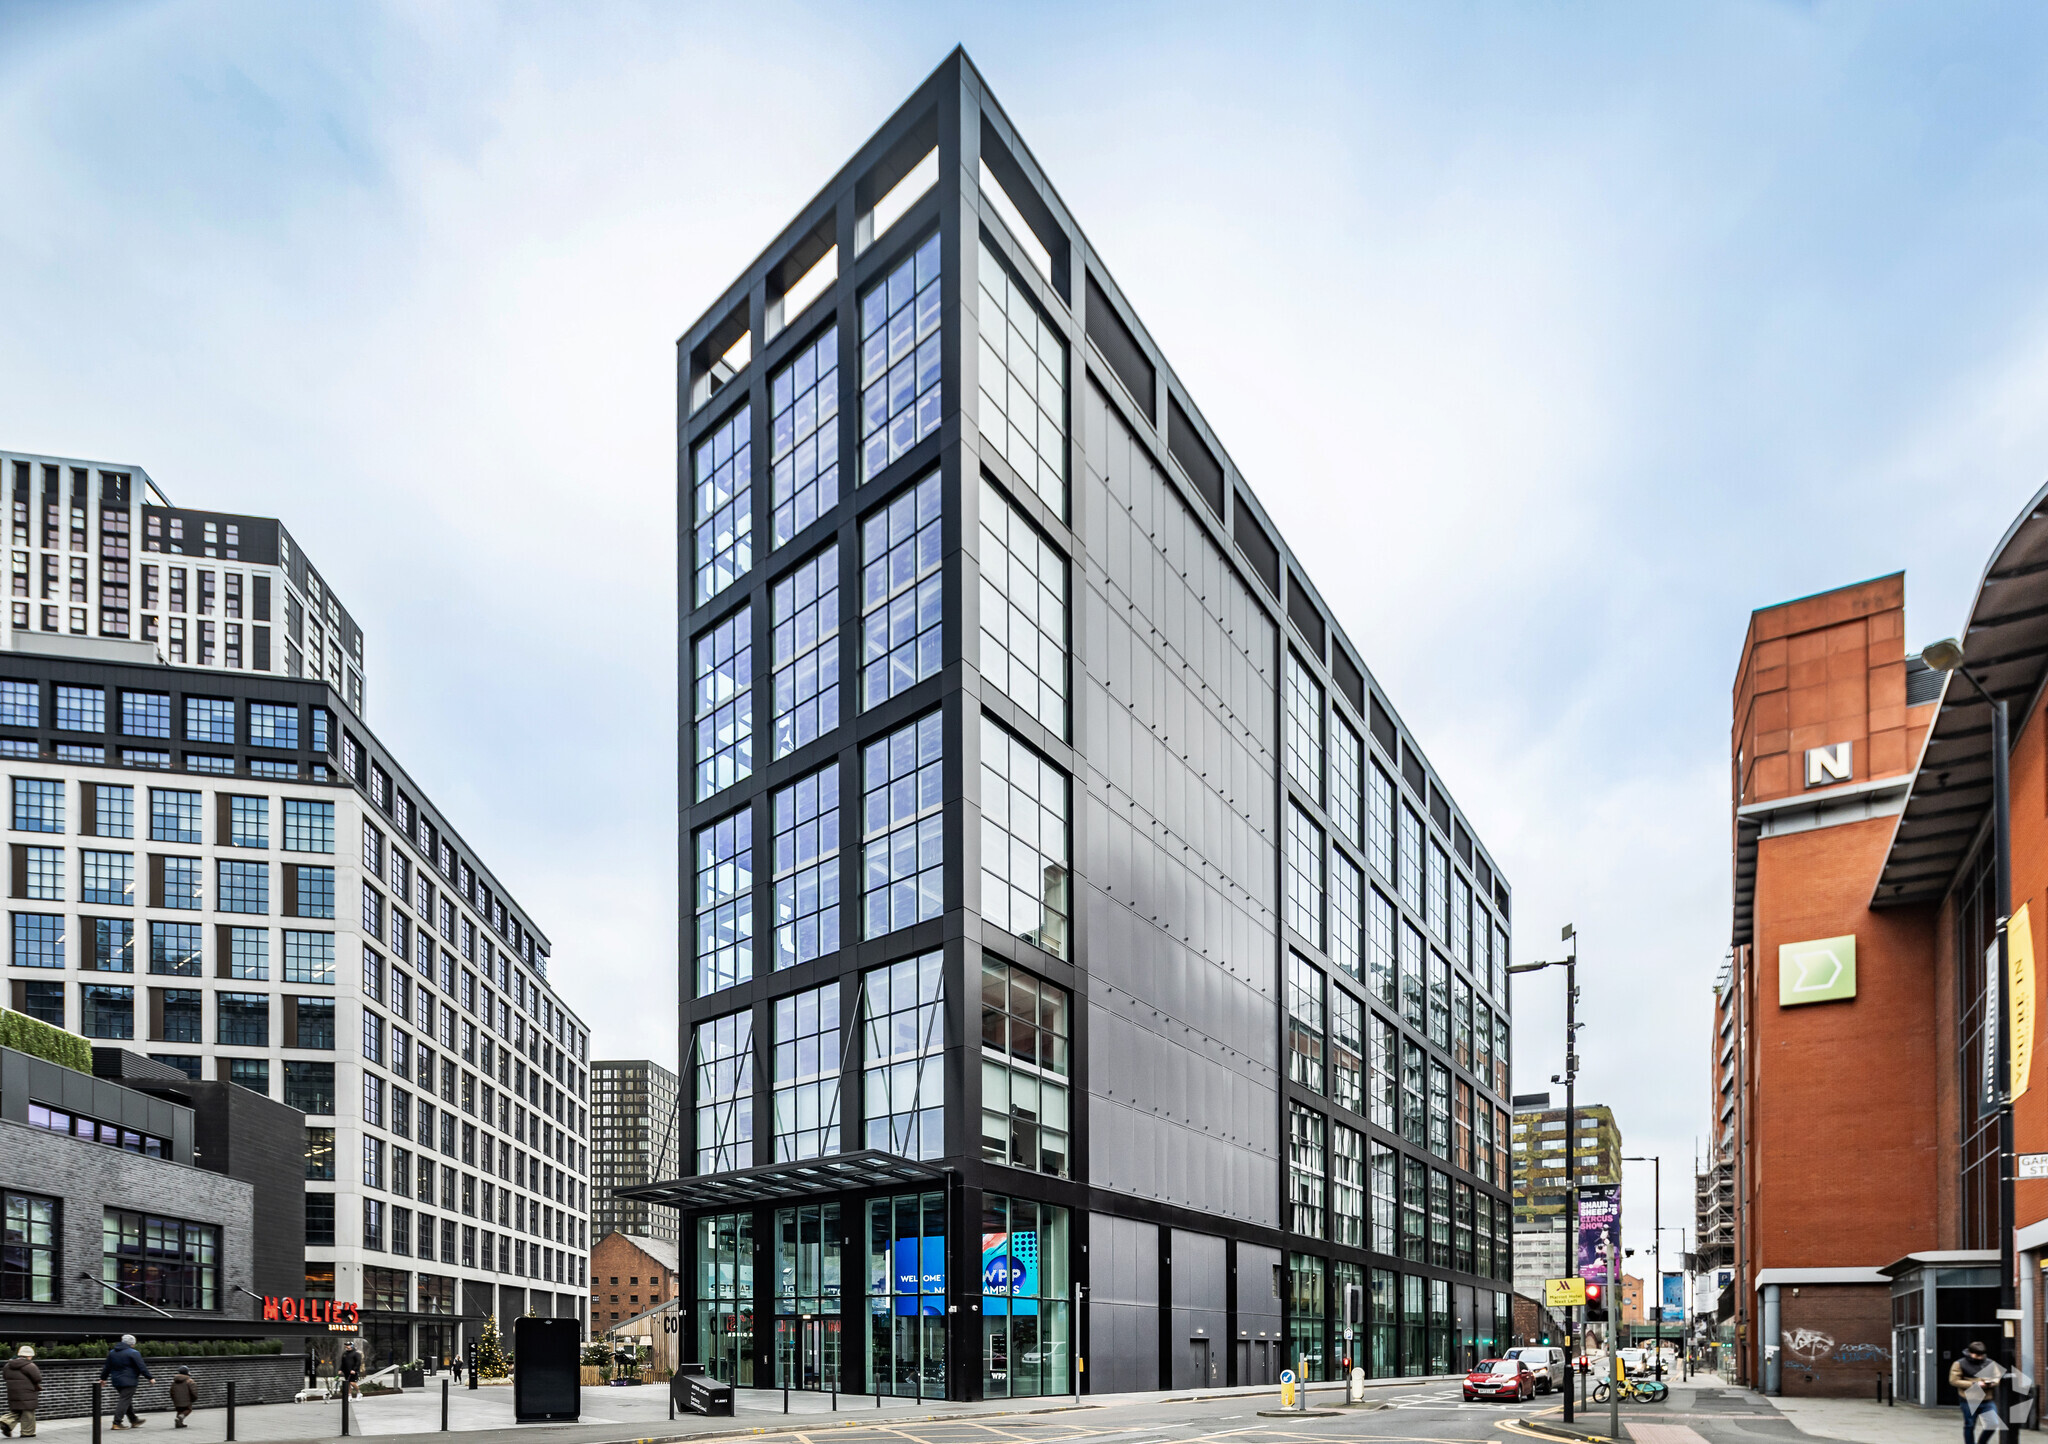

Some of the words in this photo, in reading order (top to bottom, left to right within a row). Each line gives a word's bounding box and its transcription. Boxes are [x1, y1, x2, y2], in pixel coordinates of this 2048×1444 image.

[1809, 742, 1850, 784] N
[2030, 1165, 2048, 1175] ST
[1580, 1201, 1608, 1209] SHAUN
[1580, 1207, 1618, 1216] SHEEP'S
[1580, 1214, 1613, 1223] CIRCUS
[1580, 1222, 1604, 1230] SHOW
[900, 1274, 942, 1283] WELOME
[263, 1296, 359, 1324] MOLLIE'S
[991, 1372, 1006, 1380] WPP
